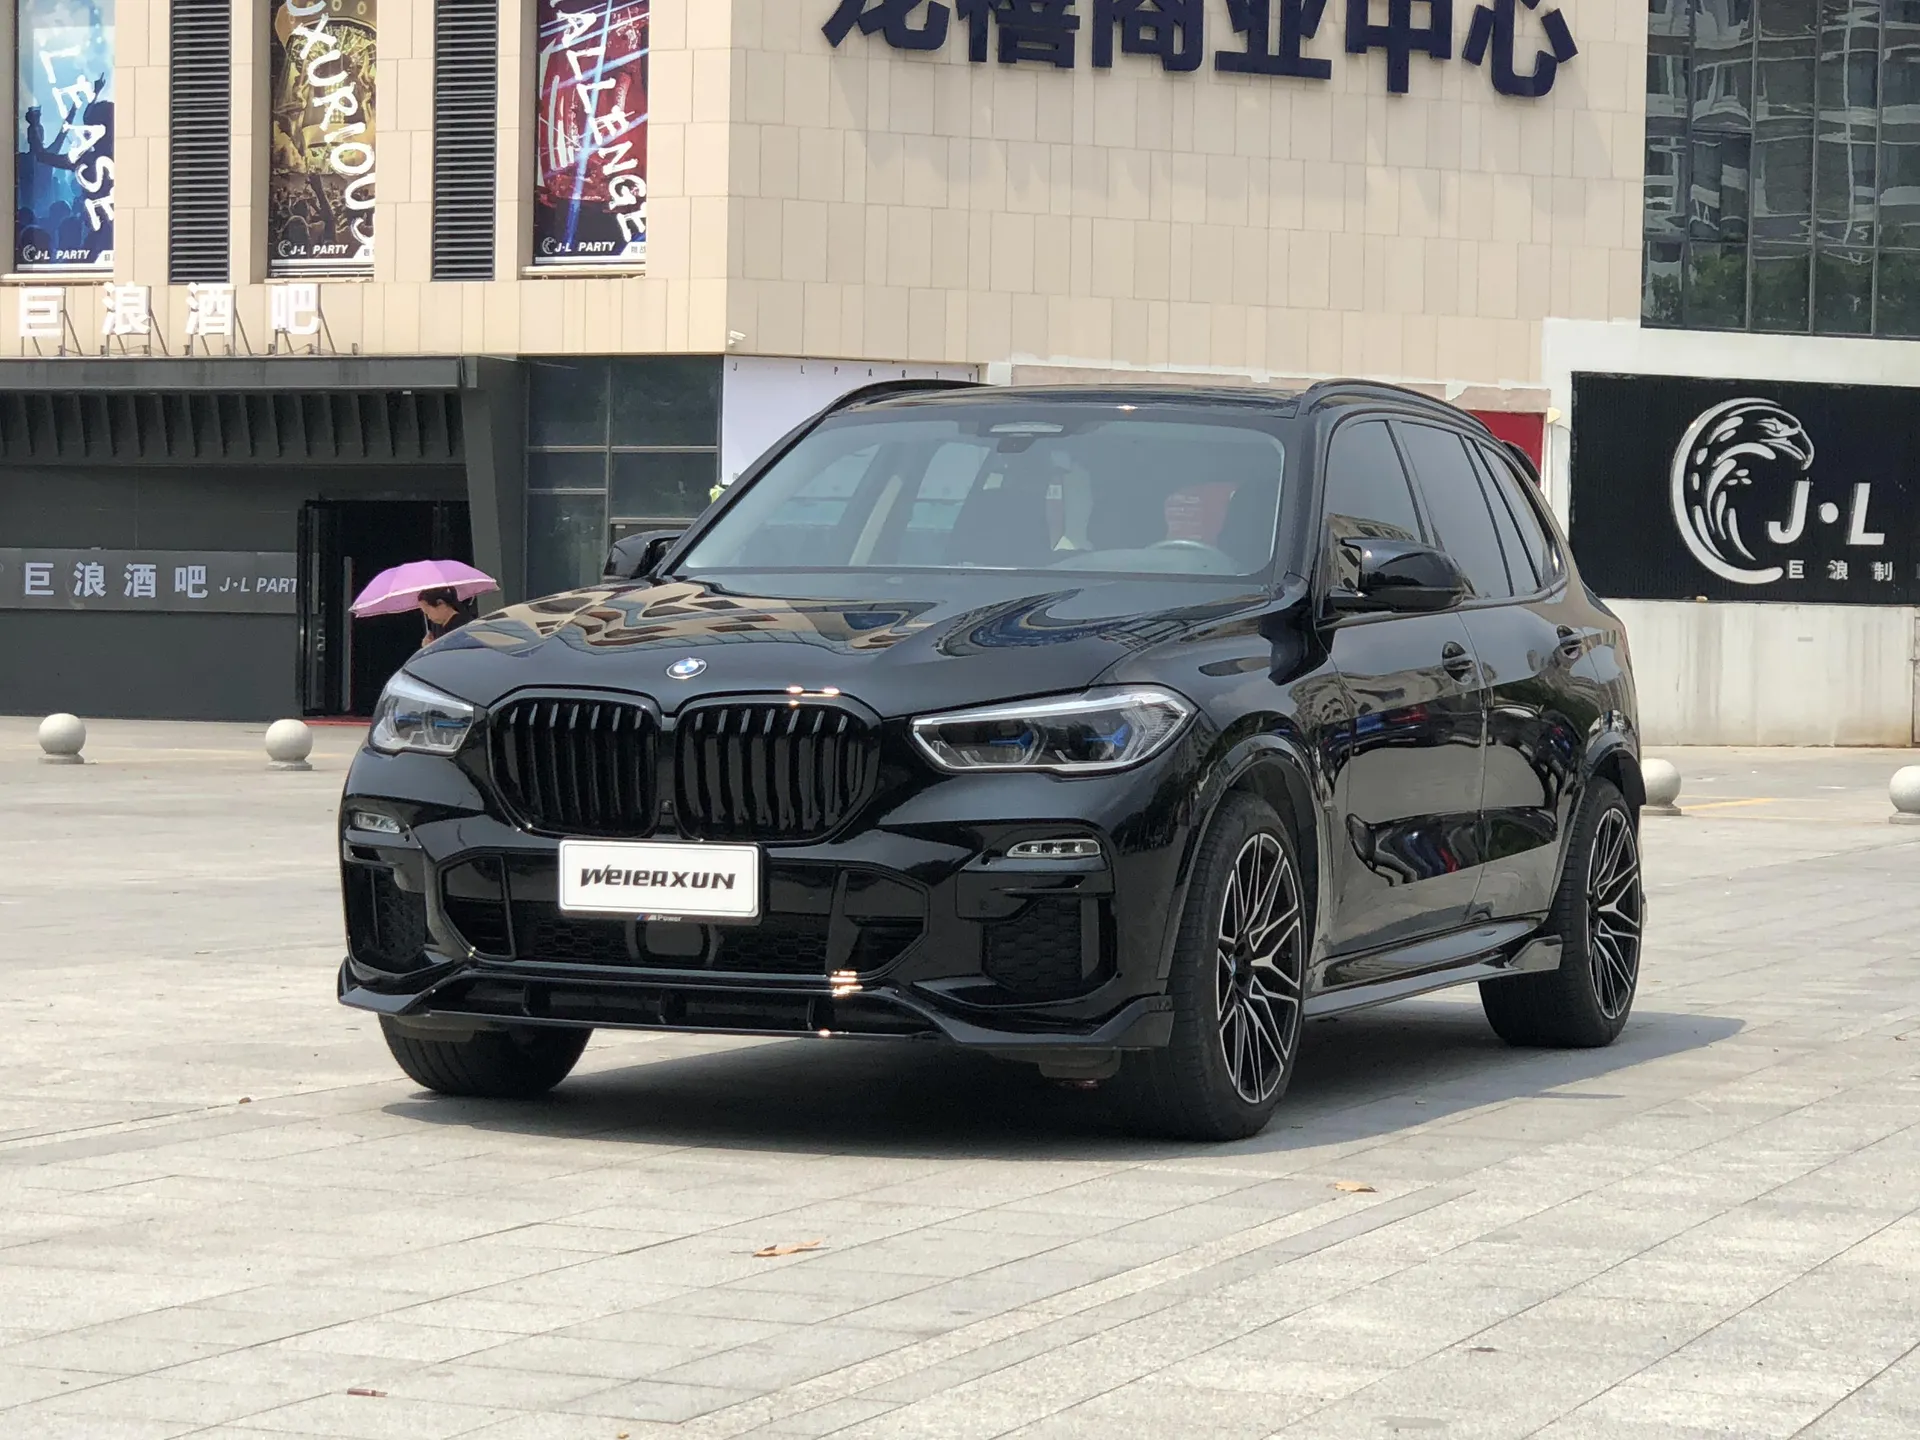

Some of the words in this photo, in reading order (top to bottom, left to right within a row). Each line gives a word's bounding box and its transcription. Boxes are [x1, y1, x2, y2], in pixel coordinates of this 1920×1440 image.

[550, 0, 647, 242] ALLENGE
[56, 249, 90, 260] PARTY
[312, 244, 348, 255] PARTY
[578, 241, 615, 252] PARTY
[18, 281, 321, 338] 巨浪酒吧
[24, 561, 209, 599] 巨浪酒吧
[1786, 559, 1920, 582] 巨浪制
